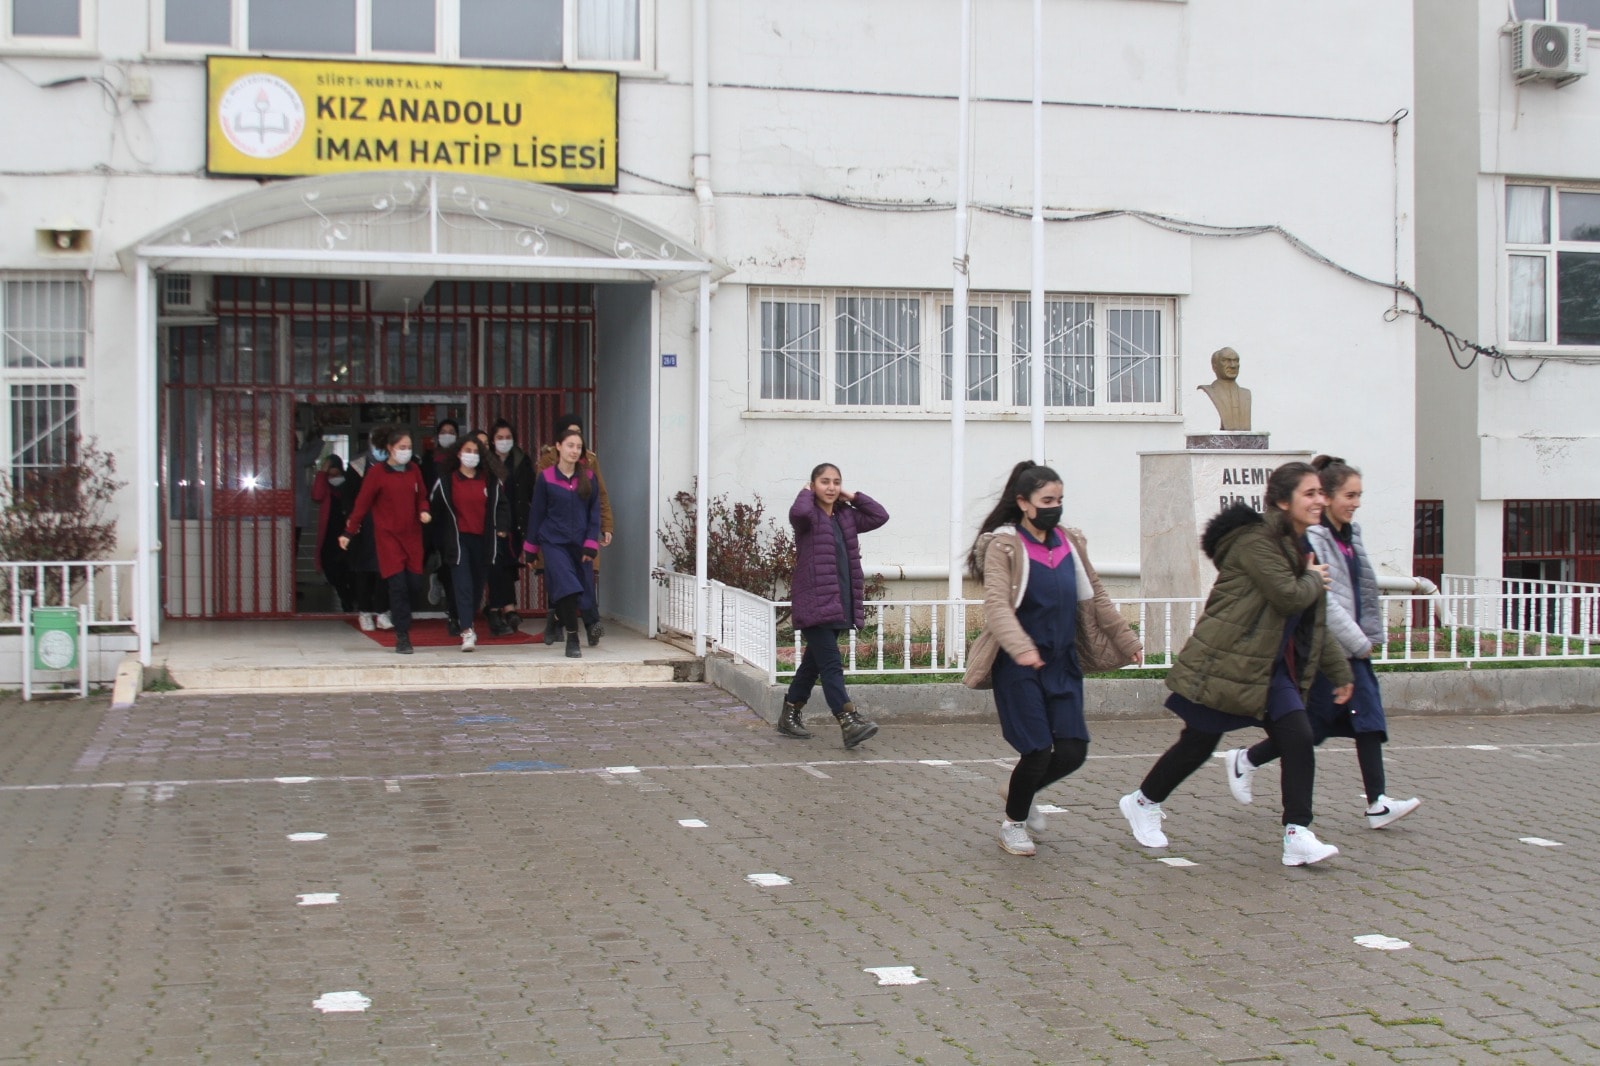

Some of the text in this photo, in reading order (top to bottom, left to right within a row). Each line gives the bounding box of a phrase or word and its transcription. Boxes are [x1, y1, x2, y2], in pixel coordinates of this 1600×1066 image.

[365, 78, 443, 90] KURTALAN
[317, 95, 522, 126] KIZ ANADOLU
[316, 129, 605, 170] İMAM HATİP LİSESİ
